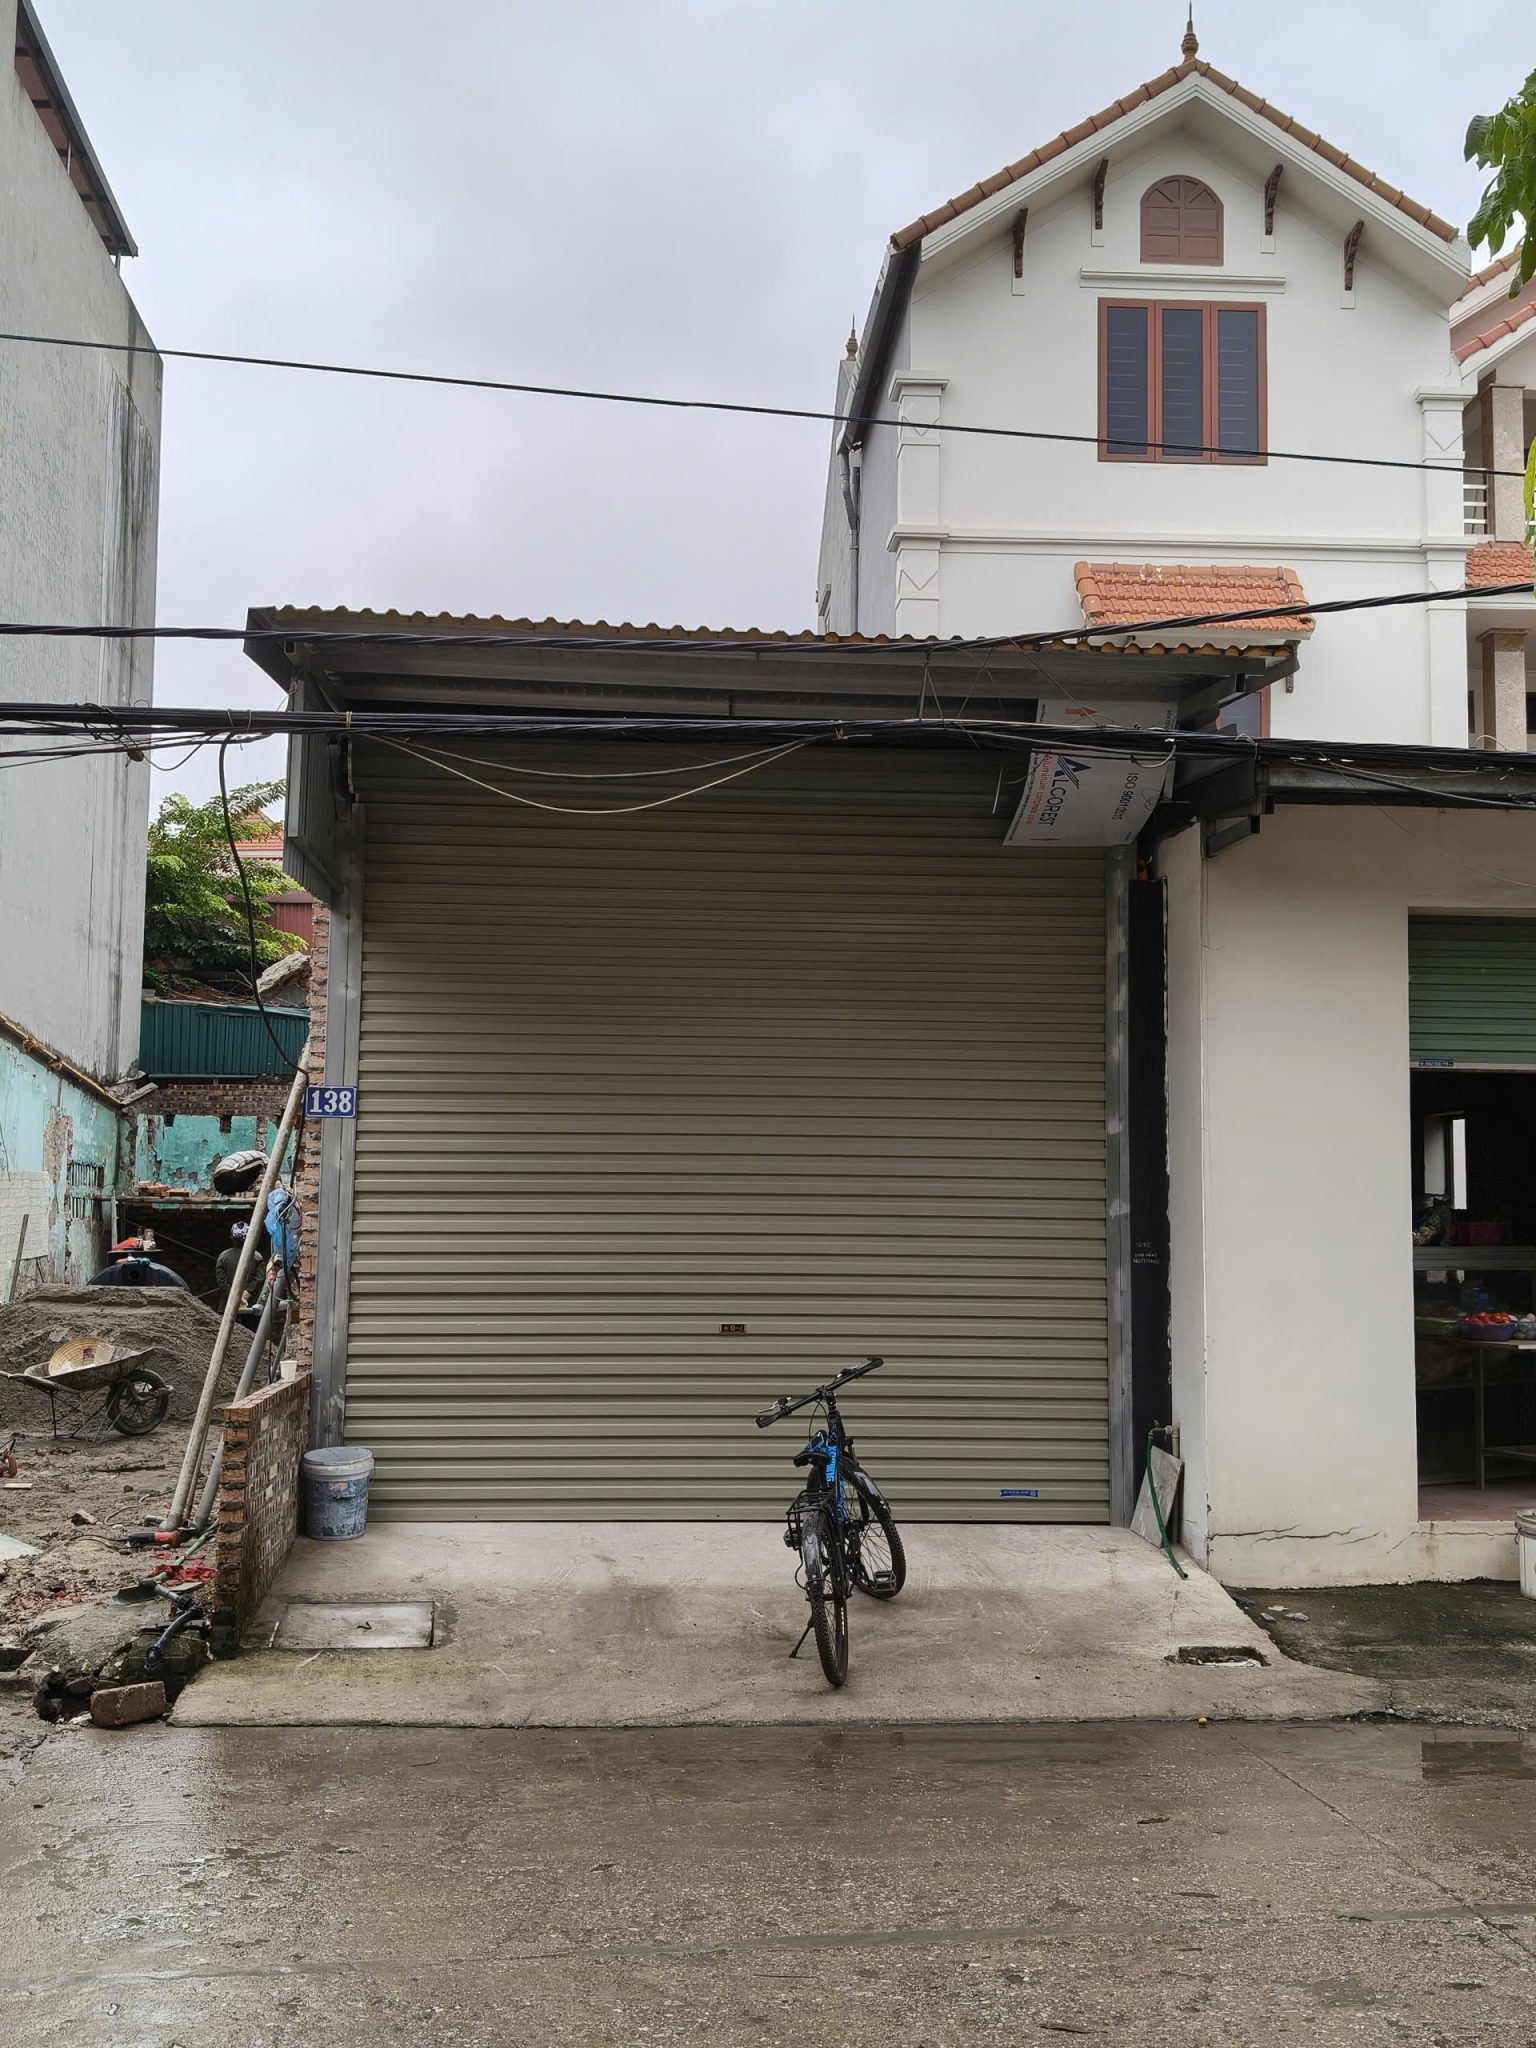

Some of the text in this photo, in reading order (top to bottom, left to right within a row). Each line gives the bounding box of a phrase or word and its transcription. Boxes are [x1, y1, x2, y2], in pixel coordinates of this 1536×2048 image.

[1040, 752, 1053, 791] Aluminum
[1124, 772, 1139, 788] ISO
[1038, 755, 1092, 826] ALCOREST
[309, 1089, 352, 1113] 138
